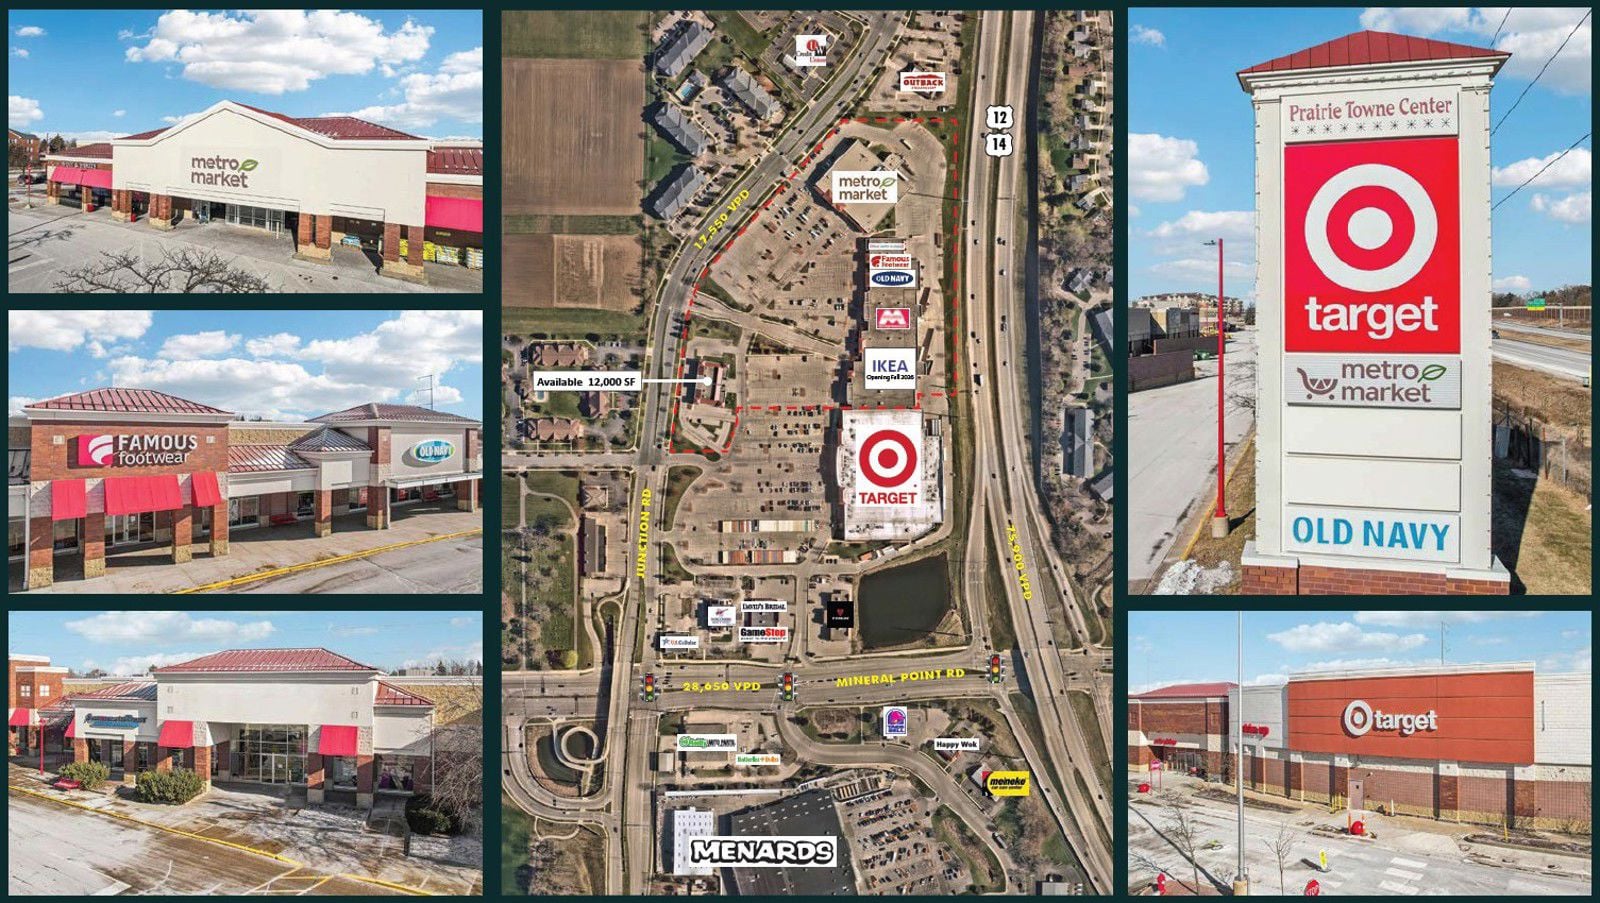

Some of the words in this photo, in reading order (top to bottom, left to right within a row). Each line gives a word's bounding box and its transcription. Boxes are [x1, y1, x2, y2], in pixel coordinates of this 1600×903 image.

[1289, 103, 1342, 121] Prairie
[1345, 101, 1395, 118] Towne
[1399, 97, 1452, 115] Center
[191, 155, 240, 170] metro
[191, 171, 249, 188] market
[1304, 296, 1439, 340] target
[1342, 361, 1419, 380] metro
[1342, 383, 1432, 403] market
[118, 434, 198, 451] FAMOUS
[419, 446, 434, 457] OLD
[118, 451, 190, 465] footwear
[1292, 516, 1354, 545] OLD
[1362, 520, 1450, 551] NAVY
[1373, 710, 1438, 735] target
